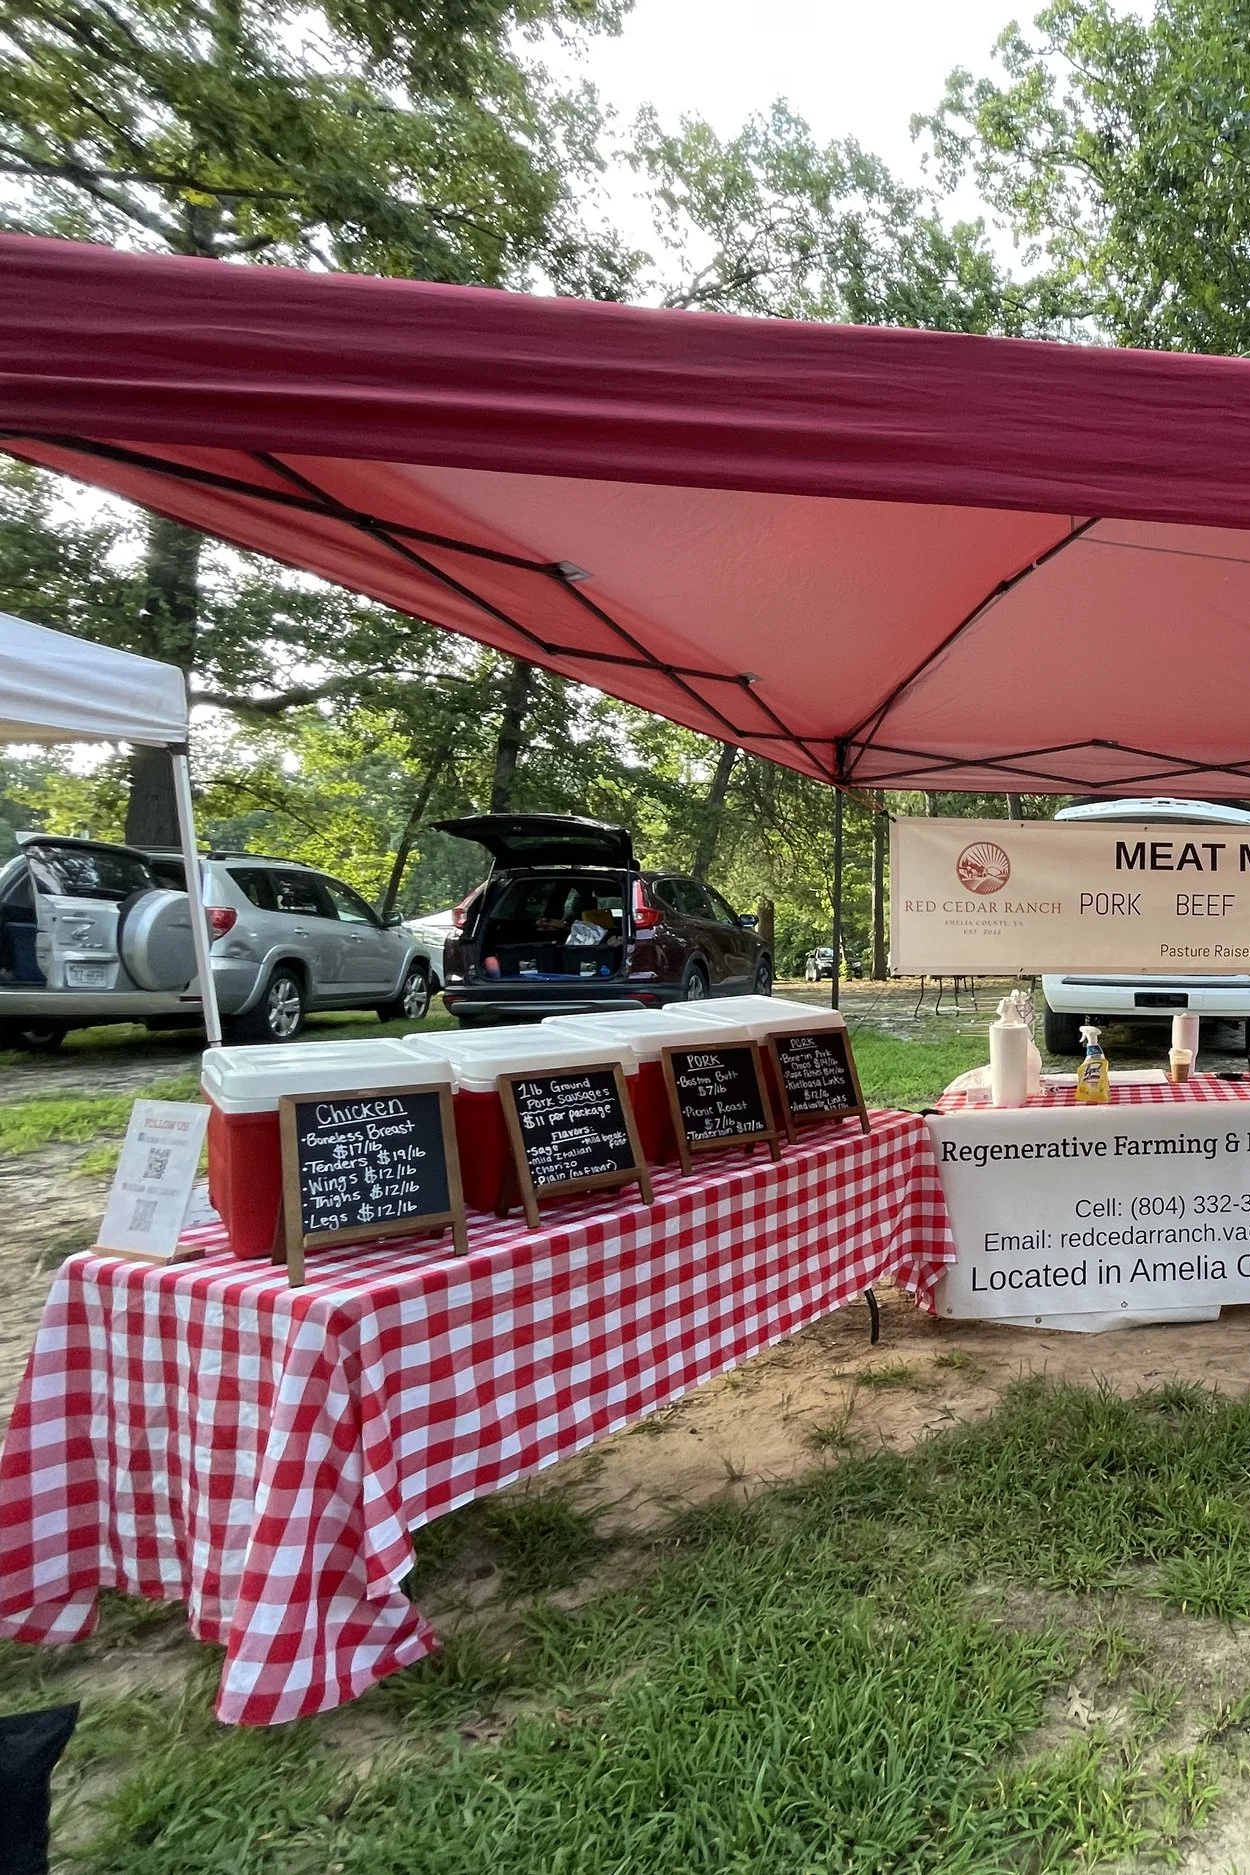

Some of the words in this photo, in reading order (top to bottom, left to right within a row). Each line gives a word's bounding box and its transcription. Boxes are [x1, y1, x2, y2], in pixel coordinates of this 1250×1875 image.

[1115, 841, 1226, 871] MEAT
[905, 900, 937, 912] RED
[943, 901, 998, 913] CEDAR
[1005, 902, 1062, 914] RANCH
[1080, 892, 1141, 916] PORK
[1176, 894, 1235, 916] BEEF
[1160, 944, 1210, 958] Pasture
[790, 1038, 815, 1049] PORK
[686, 1055, 720, 1068] PORK
[550, 1078, 591, 1093] Ground
[680, 1076, 711, 1088] Boston
[715, 1070, 739, 1082] Butt
[698, 1083, 727, 1097] $7/lb
[316, 1099, 404, 1125] Chicken
[527, 1098, 555, 1109] Pork
[686, 1106, 714, 1117] Picnic
[716, 1100, 747, 1114] Roast
[523, 1114, 545, 1129] $11
[549, 1112, 565, 1125] per
[569, 1104, 611, 1122] package
[704, 1115, 736, 1130] $7/lb
[306, 1131, 364, 1146] Boneless
[366, 1120, 415, 1140] Breast
[551, 1126, 595, 1141] Flavors:
[333, 1140, 382, 1159] $17/lb
[530, 1145, 559, 1156] Sage
[554, 1146, 592, 1160] Italian
[941, 1136, 1108, 1168] Regenerative
[1113, 1134, 1218, 1160] Farming
[1226, 1132, 1241, 1153] &
[305, 1157, 368, 1174] Tenders
[377, 1145, 426, 1164] $19/lb
[536, 1160, 578, 1175] Chorizo
[308, 1173, 358, 1195] Wings
[364, 1164, 417, 1183] $12/lb
[538, 1173, 566, 1185] Plain
[310, 1190, 361, 1209] Thighs
[370, 1181, 420, 1200] $12/lb
[310, 1213, 348, 1230] Legs
[357, 1200, 417, 1221] $12/lb
[1075, 1198, 1122, 1218] Cell:
[1131, 1195, 1186, 1221] (804)
[985, 1230, 1052, 1252] Email:
[972, 1260, 1087, 1292] Located
[1098, 1259, 1121, 1285] in
[1130, 1254, 1228, 1283] Amelia
